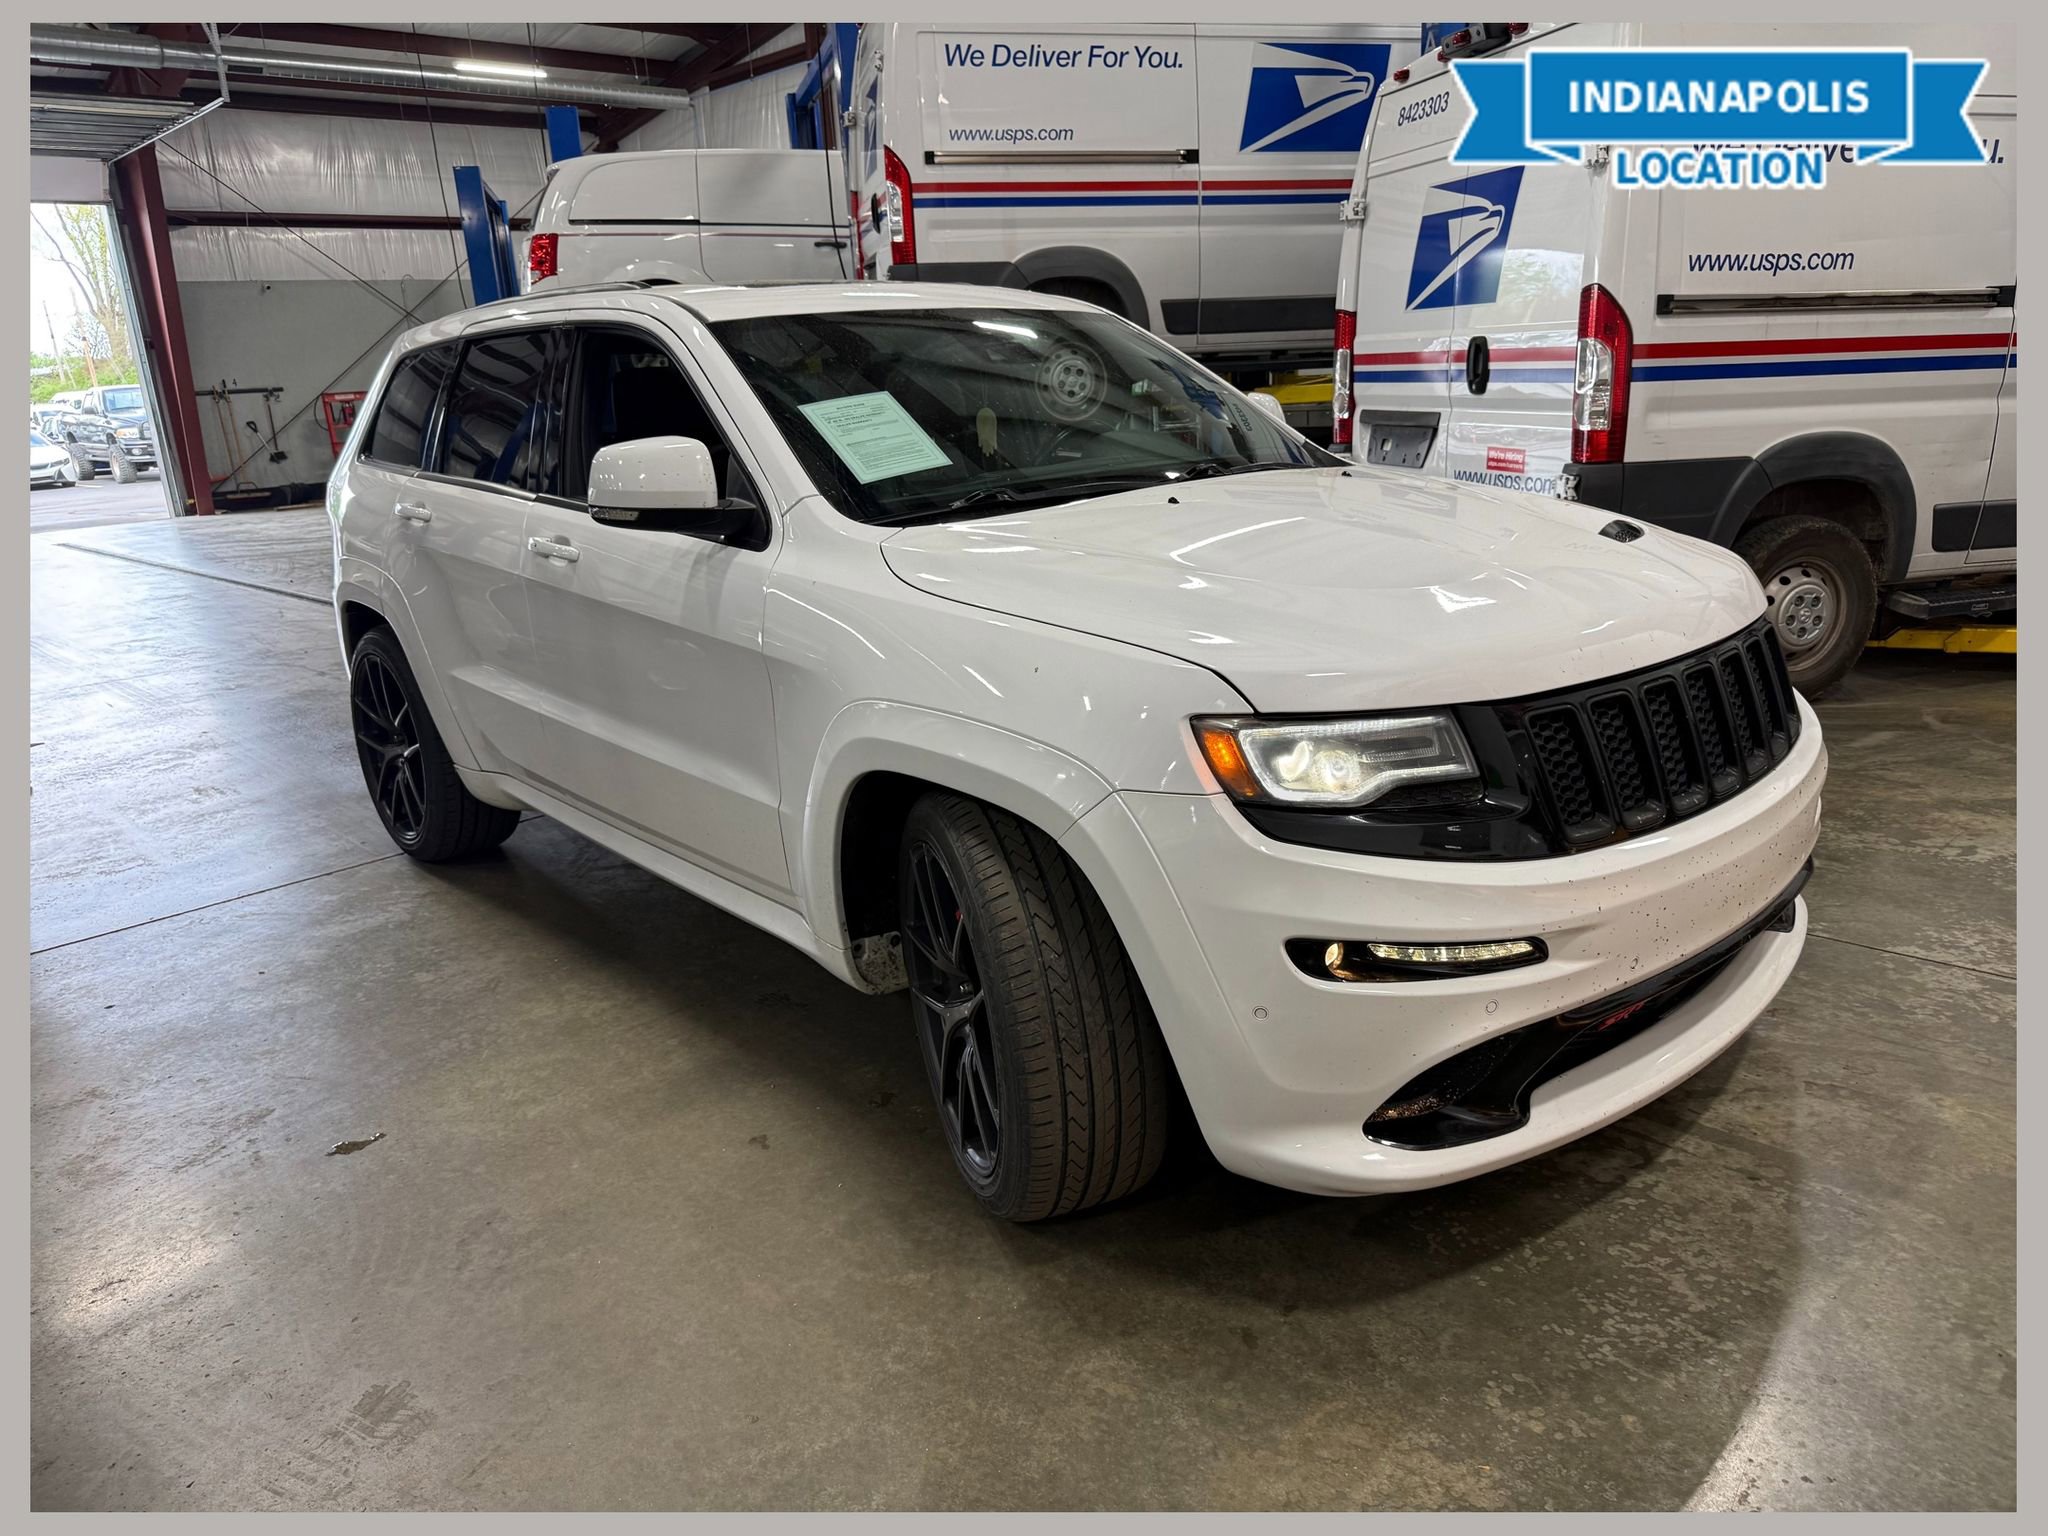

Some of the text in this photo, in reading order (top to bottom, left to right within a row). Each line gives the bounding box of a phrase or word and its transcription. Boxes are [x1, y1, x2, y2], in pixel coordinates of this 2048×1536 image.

[944, 44, 1184, 69] We Deliver For You.
[1398, 91, 1450, 127] 8423303
[949, 127, 1074, 144] www.usps.com
[1689, 252, 1854, 277] www.usps.com
